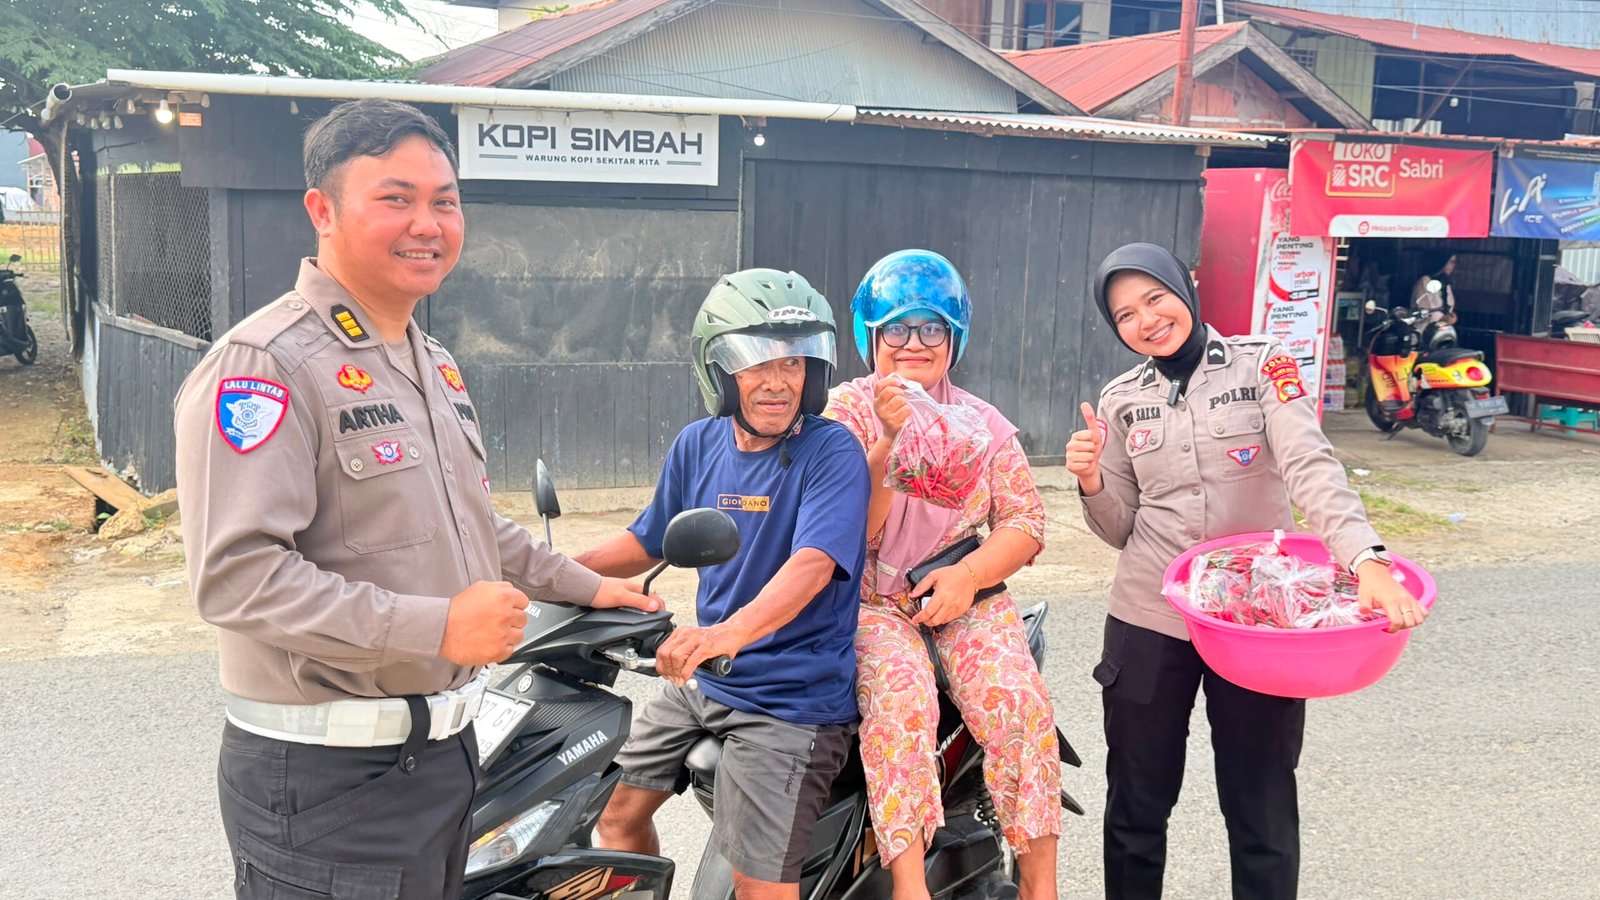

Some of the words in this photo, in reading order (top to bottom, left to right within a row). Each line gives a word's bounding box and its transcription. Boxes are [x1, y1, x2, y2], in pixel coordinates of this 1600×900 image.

[478, 123, 557, 149] KOPI
[570, 127, 703, 155] SIMBAH
[525, 154, 568, 163] WARUNG
[570, 155, 593, 164] KOPI
[596, 157, 636, 165] SEKITAR
[638, 158, 660, 166] KITA
[1334, 142, 1386, 160] TOKO
[1348, 163, 1390, 188] SRC
[1398, 157, 1444, 179] Sabri
[773, 308, 813, 318] INK
[1271, 311, 1308, 319] PENTING
[224, 380, 248, 390] LALU
[250, 381, 284, 398] LINTAS
[1209, 386, 1257, 410] POLRI
[339, 403, 405, 434] ARTHA
[1136, 406, 1162, 421] SALSA
[722, 497, 767, 507] GIORDANO
[556, 730, 609, 766] YAMAHA
